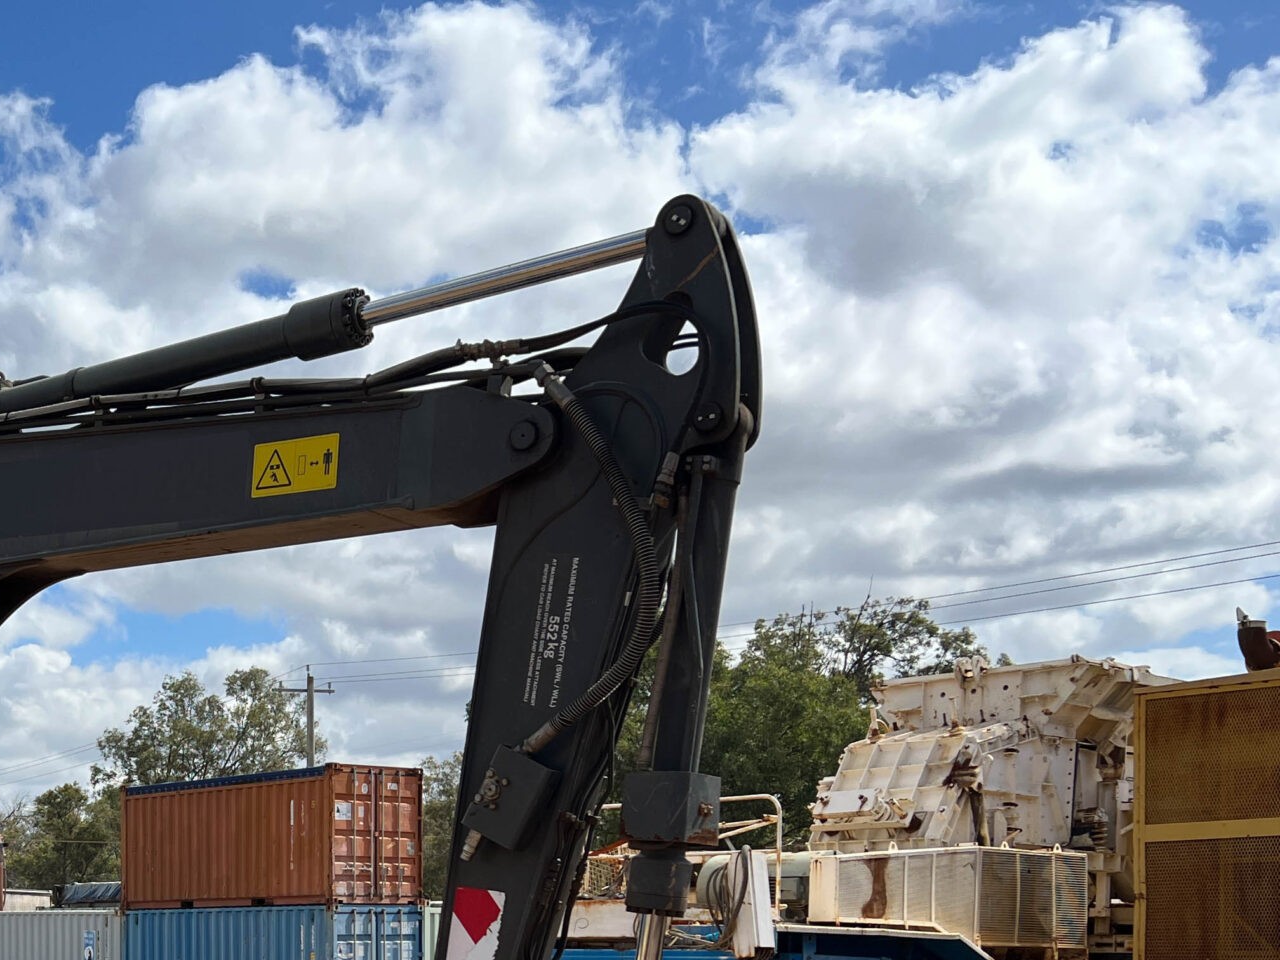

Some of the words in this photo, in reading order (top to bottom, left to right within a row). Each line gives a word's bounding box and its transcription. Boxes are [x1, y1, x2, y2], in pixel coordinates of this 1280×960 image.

[568, 557, 579, 594] MAXIMUM
[564, 596, 573, 622] RATED
[557, 624, 569, 662] CAPACITY
[554, 664, 563, 683] (SWL
[549, 689, 559, 707] WLL)
